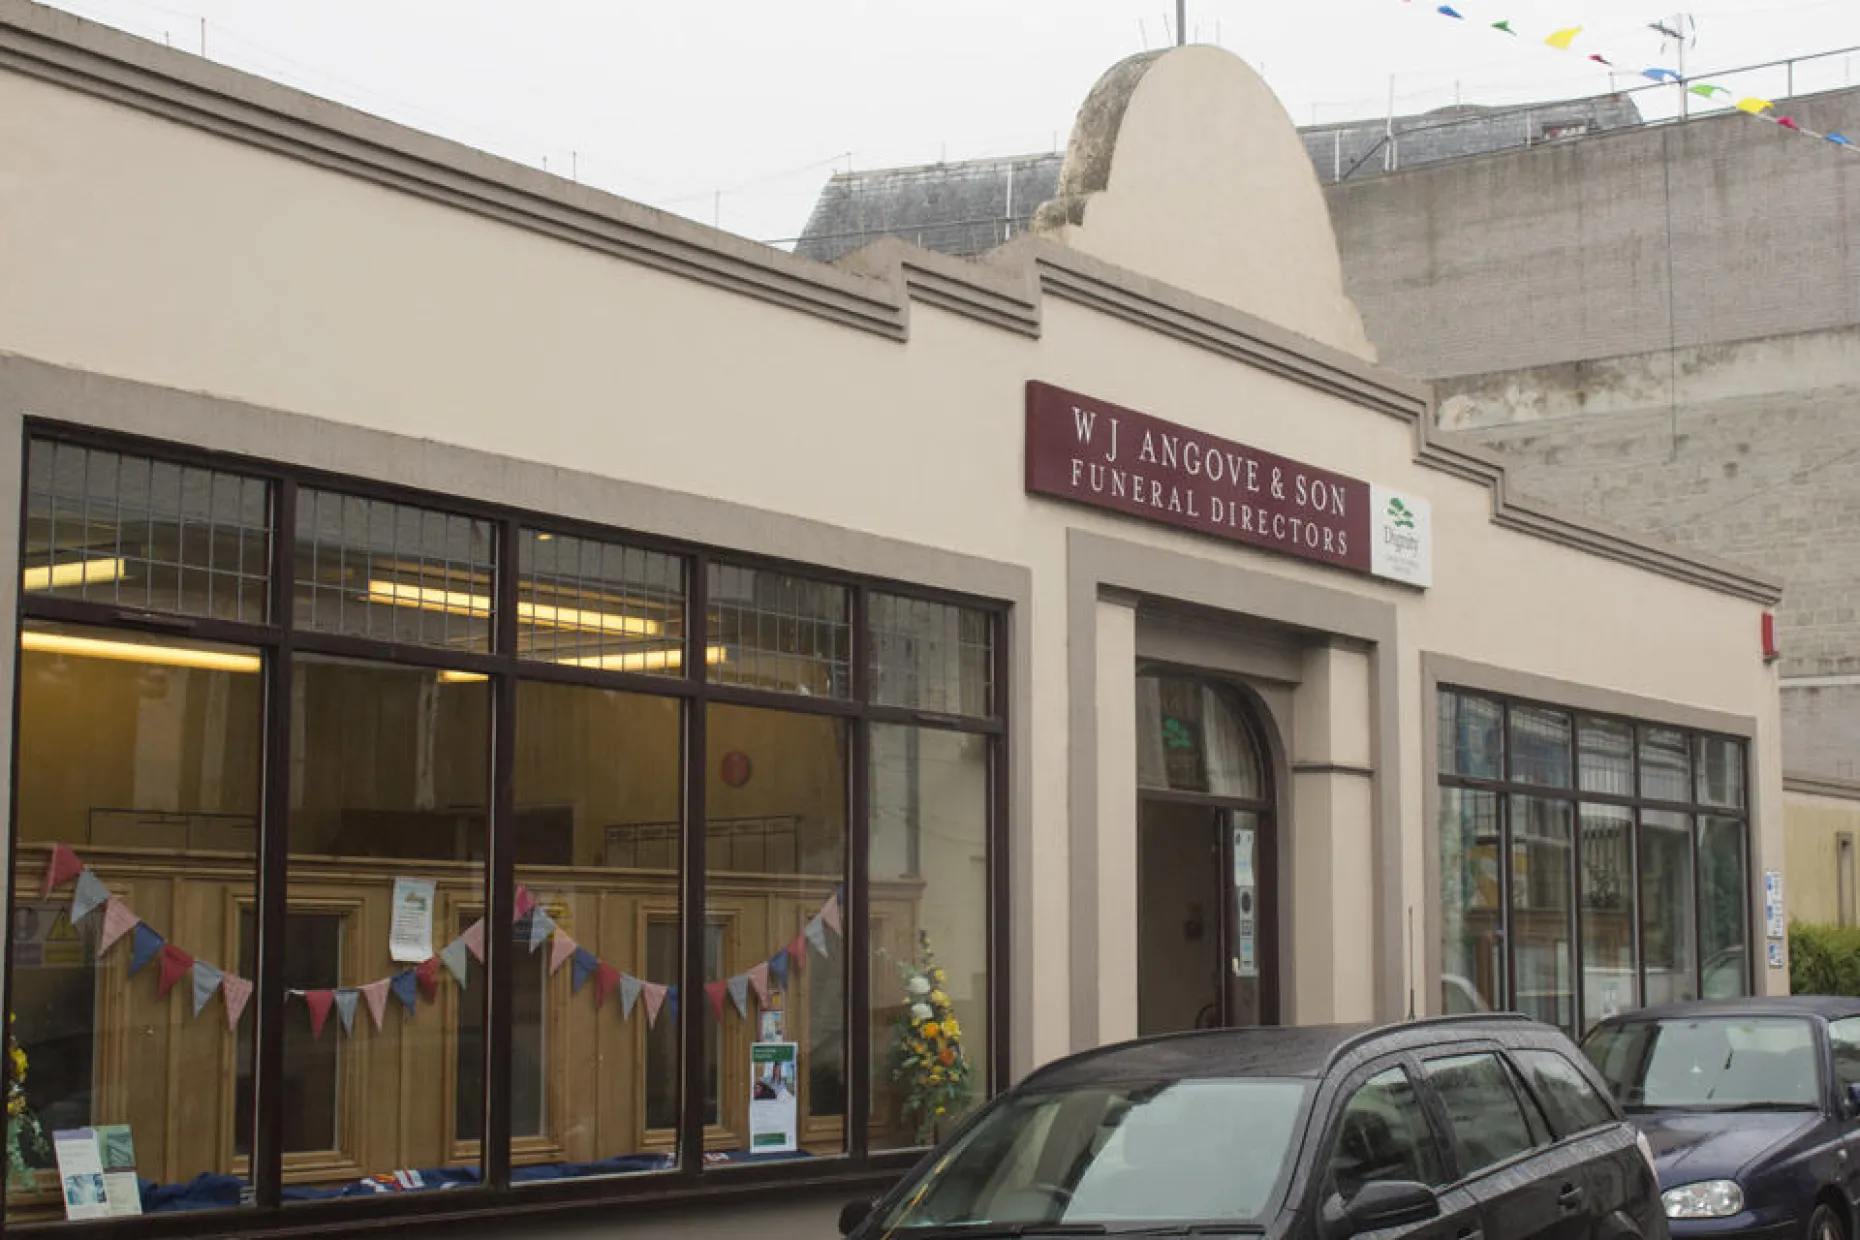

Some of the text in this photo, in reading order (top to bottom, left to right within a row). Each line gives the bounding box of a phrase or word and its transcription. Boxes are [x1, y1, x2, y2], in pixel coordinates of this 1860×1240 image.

[1071, 406, 1346, 516] W J ANGOVE & SON
[1071, 458, 1349, 556] FUNERAL DIRECTORS
